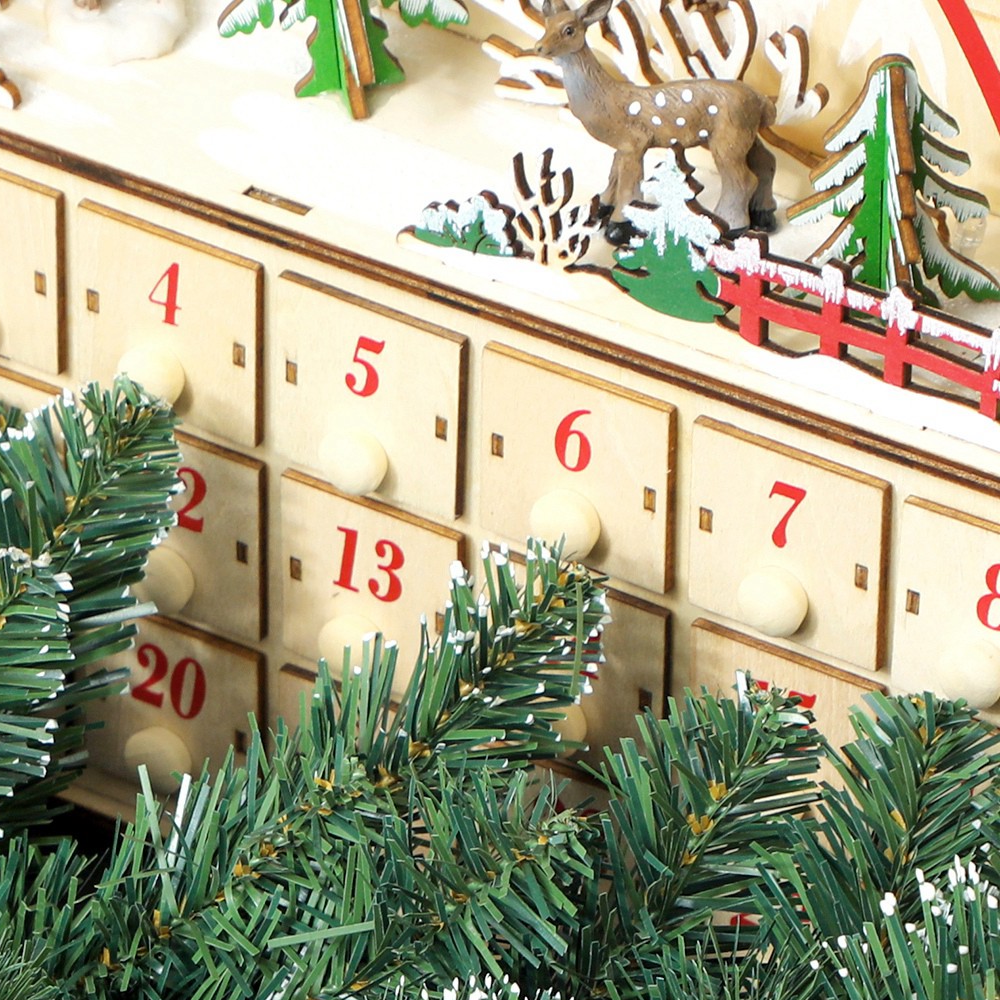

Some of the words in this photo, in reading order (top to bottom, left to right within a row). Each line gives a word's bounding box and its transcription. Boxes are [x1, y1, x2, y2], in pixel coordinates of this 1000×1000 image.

[147, 261, 183, 328] 4
[344, 335, 387, 398] 5
[553, 408, 593, 473] 6
[768, 480, 808, 549] 7
[331, 525, 406, 604] 13
[130, 642, 207, 720] 20
